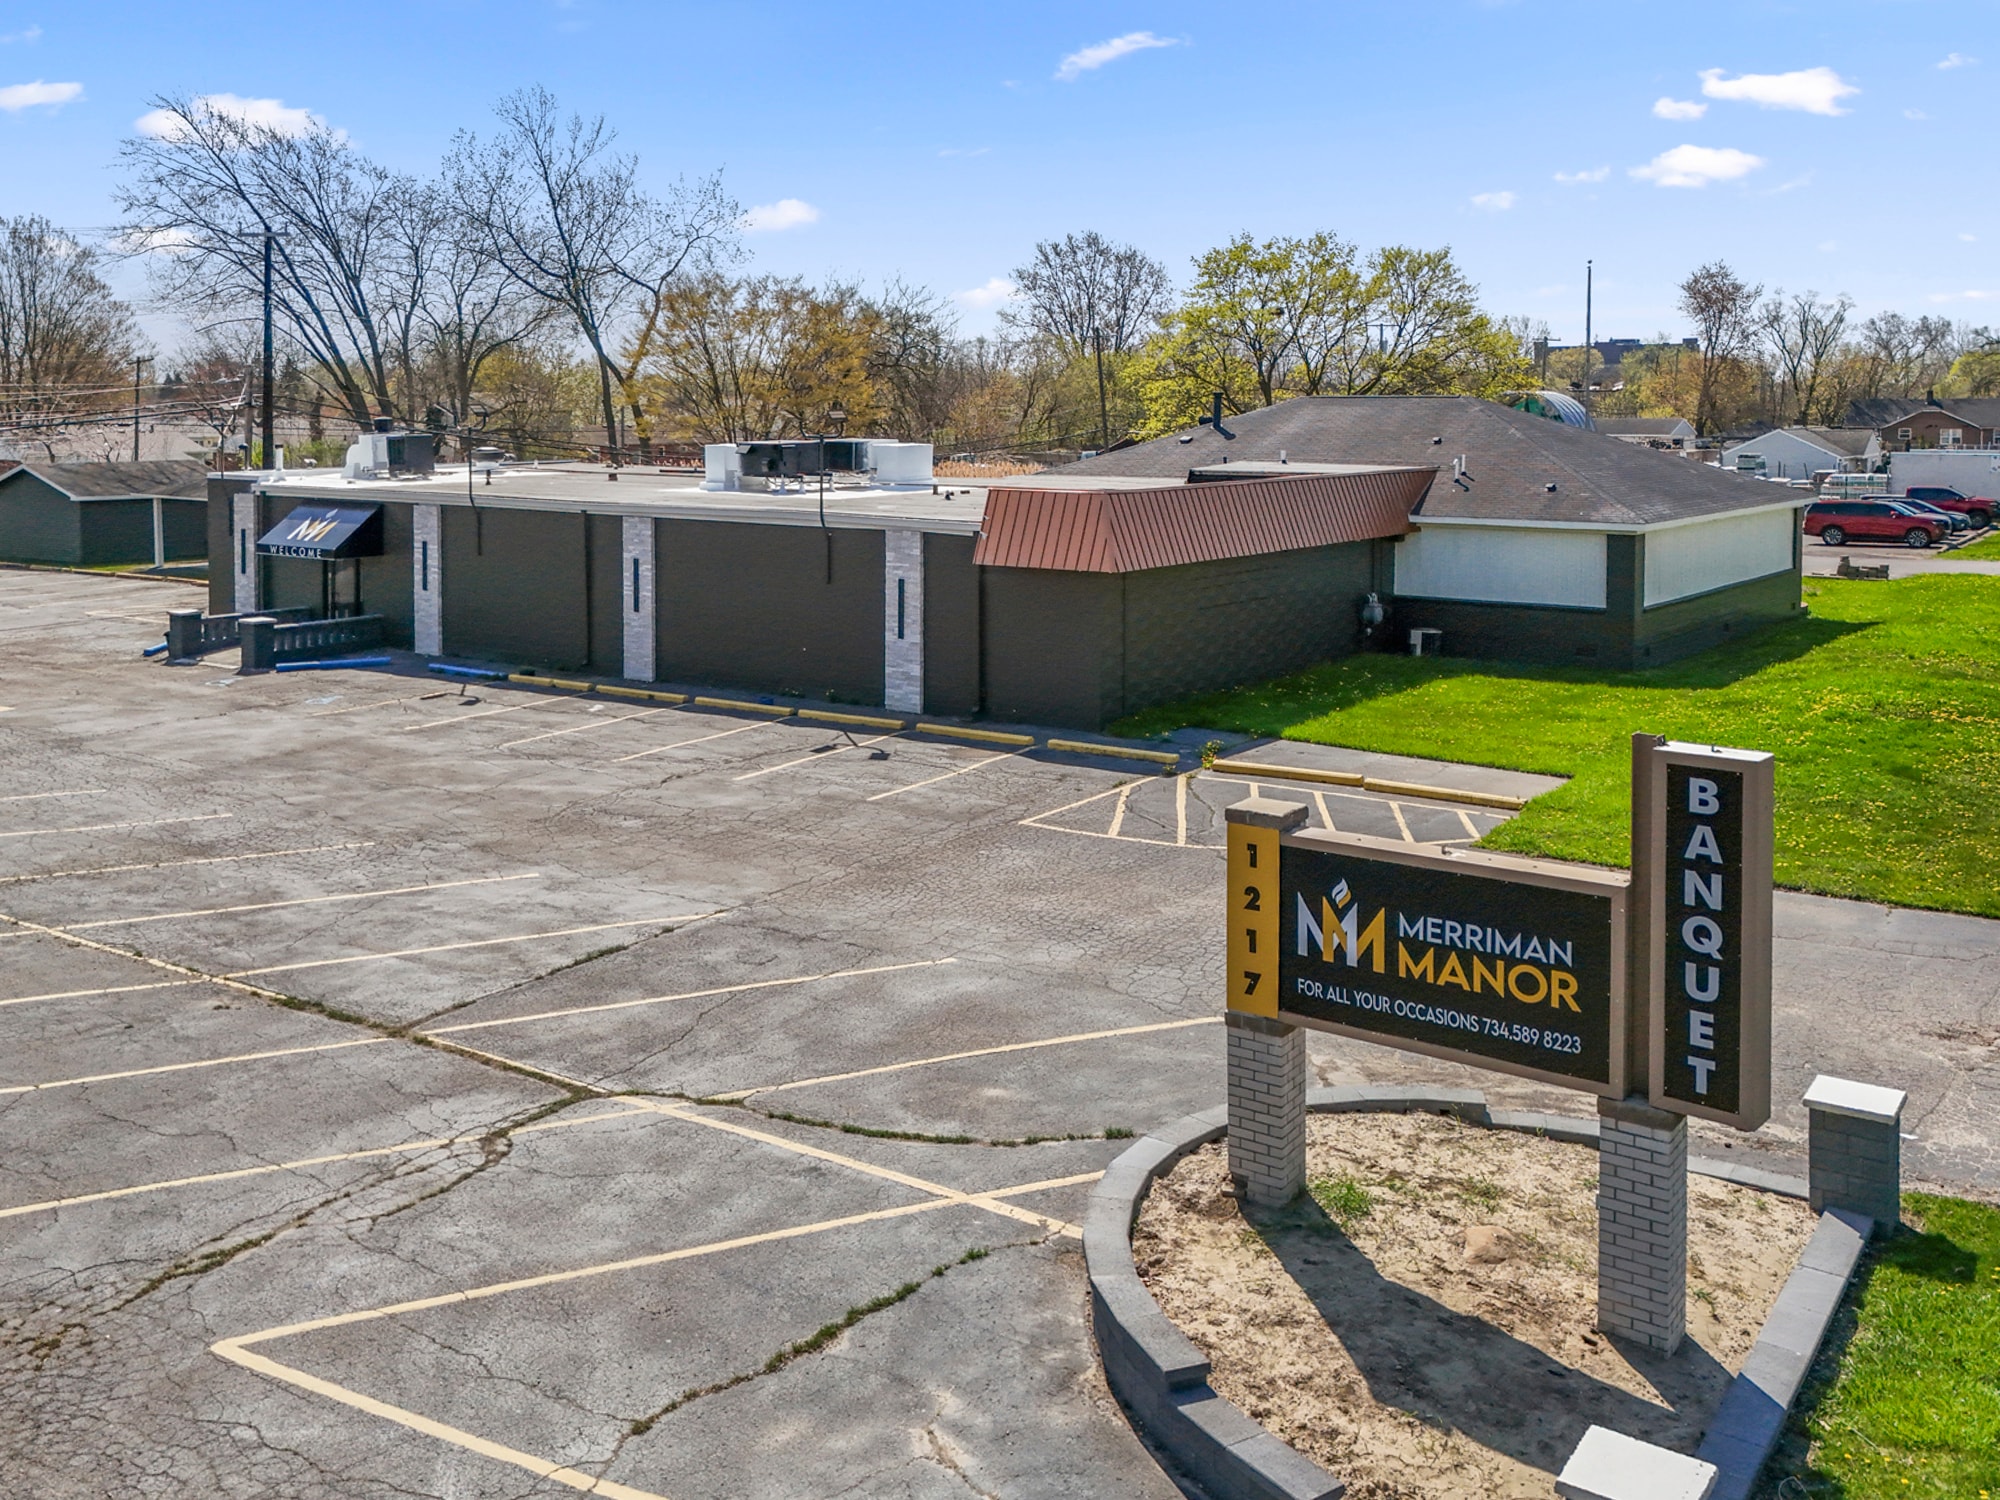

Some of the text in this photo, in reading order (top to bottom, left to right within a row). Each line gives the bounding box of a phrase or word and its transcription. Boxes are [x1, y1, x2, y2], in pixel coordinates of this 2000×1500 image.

[269, 544, 322, 559] WELCOME
[1241, 842, 1262, 996] 1217
[1399, 911, 1573, 968] MERRIMAN
[1681, 776, 1724, 1095] BANQUET
[1398, 940, 1582, 1013] MANOR
[1297, 977, 1582, 1054] FOR ALL YOUR OCCASIONS 734.589 8223
